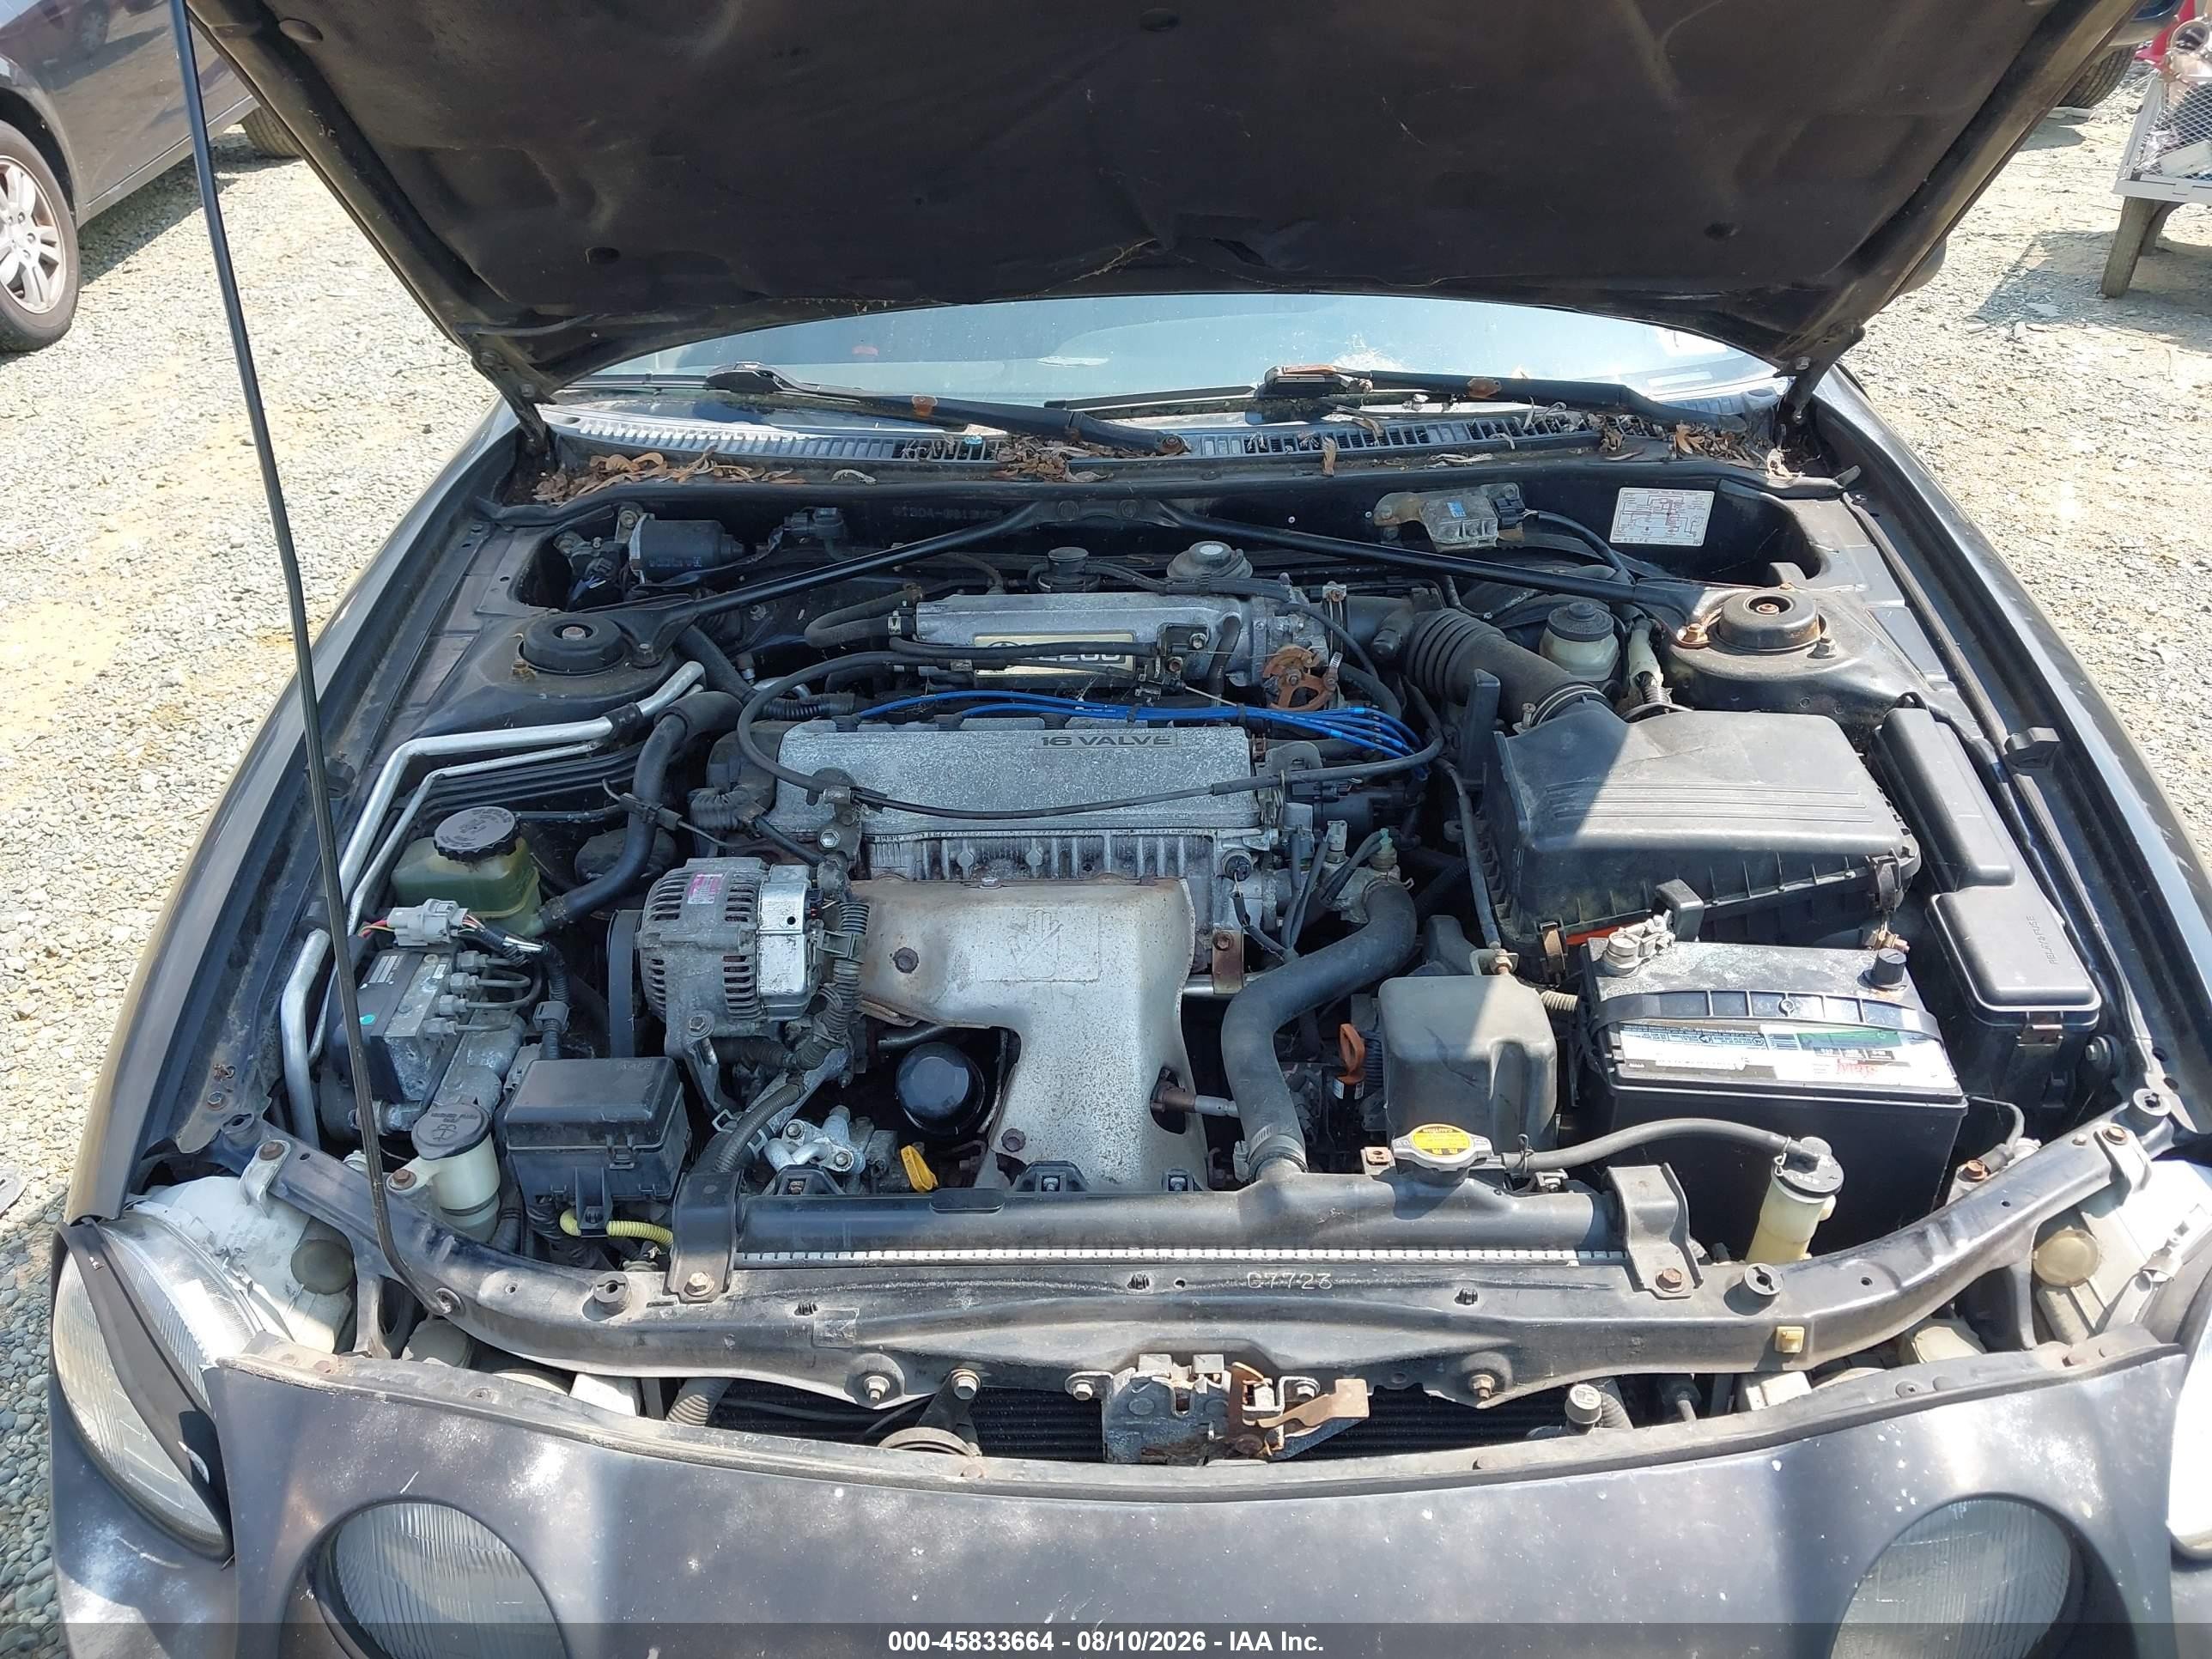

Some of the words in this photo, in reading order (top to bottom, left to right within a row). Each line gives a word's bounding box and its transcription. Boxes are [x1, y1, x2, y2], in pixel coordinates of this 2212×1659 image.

[1042, 736, 1072, 746] 16
[1078, 736, 1172, 746] VALVE
[1245, 1271, 1333, 1289] G7723
